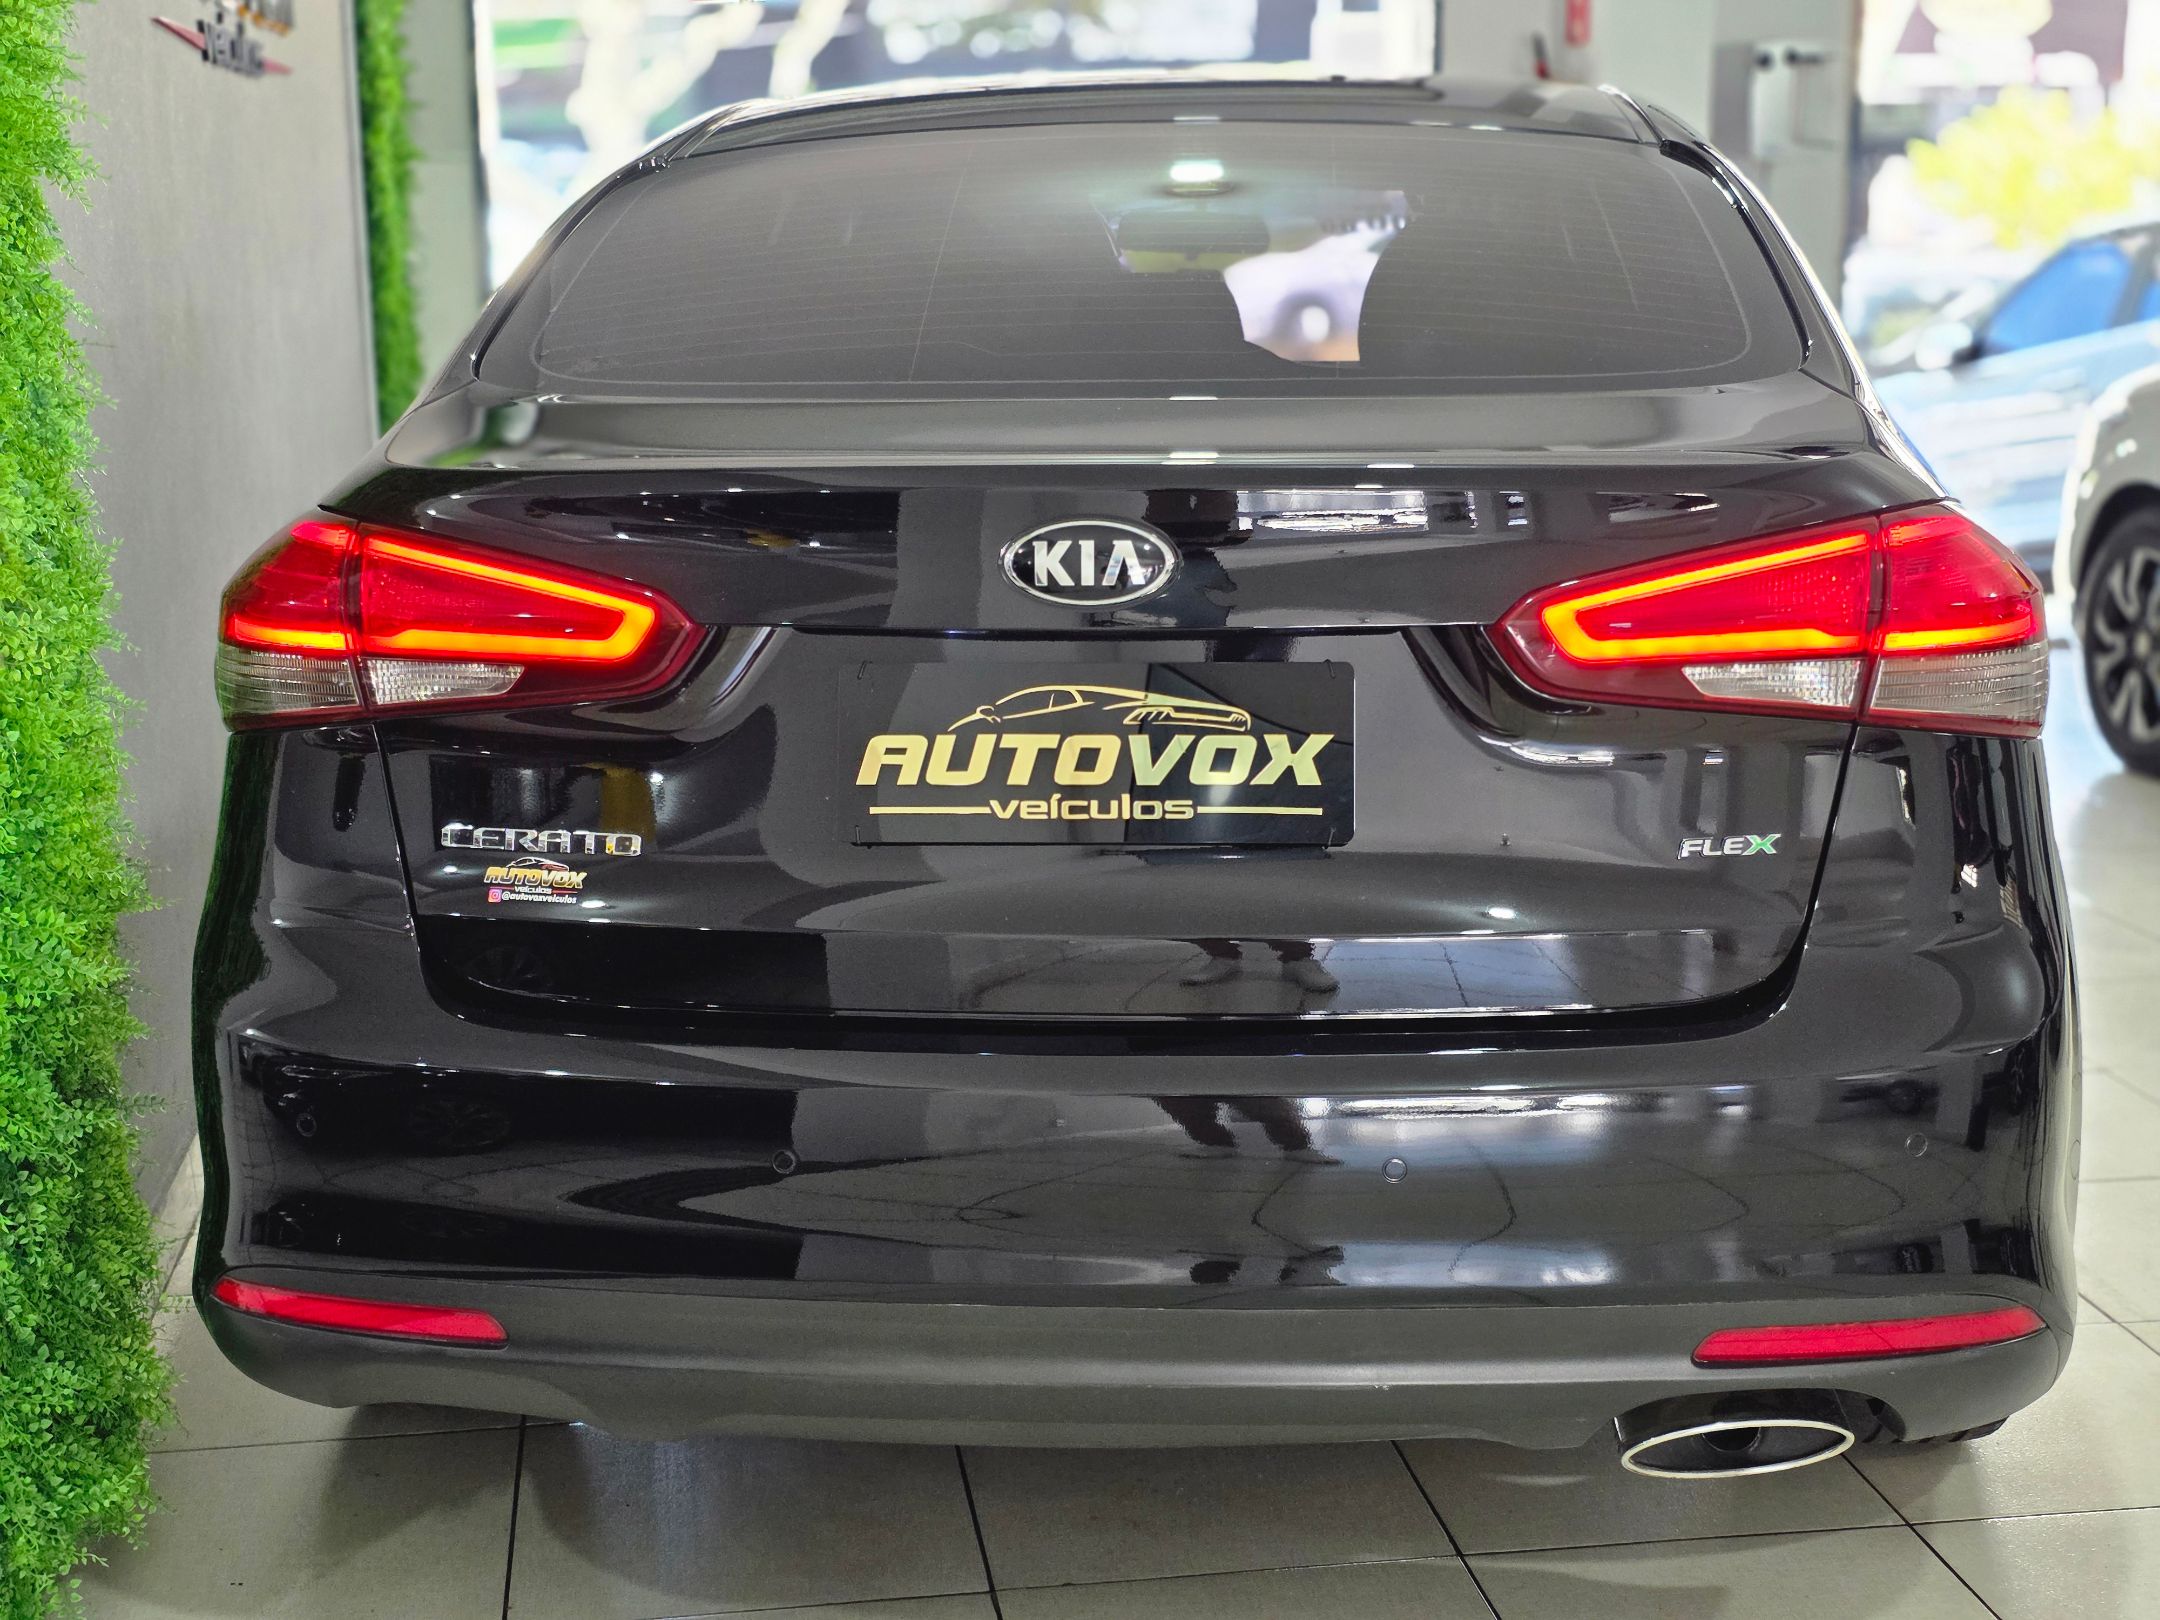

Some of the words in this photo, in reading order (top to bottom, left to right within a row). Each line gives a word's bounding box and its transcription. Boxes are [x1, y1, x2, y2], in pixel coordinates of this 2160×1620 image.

[1032, 540, 1146, 586] KIA
[855, 733, 1335, 786] AUTOVOX
[989, 793, 1194, 820] veículos
[441, 823, 642, 857] CERATO
[1677, 833, 1781, 859] FLEX
[484, 866, 587, 889] AUTOVOX
